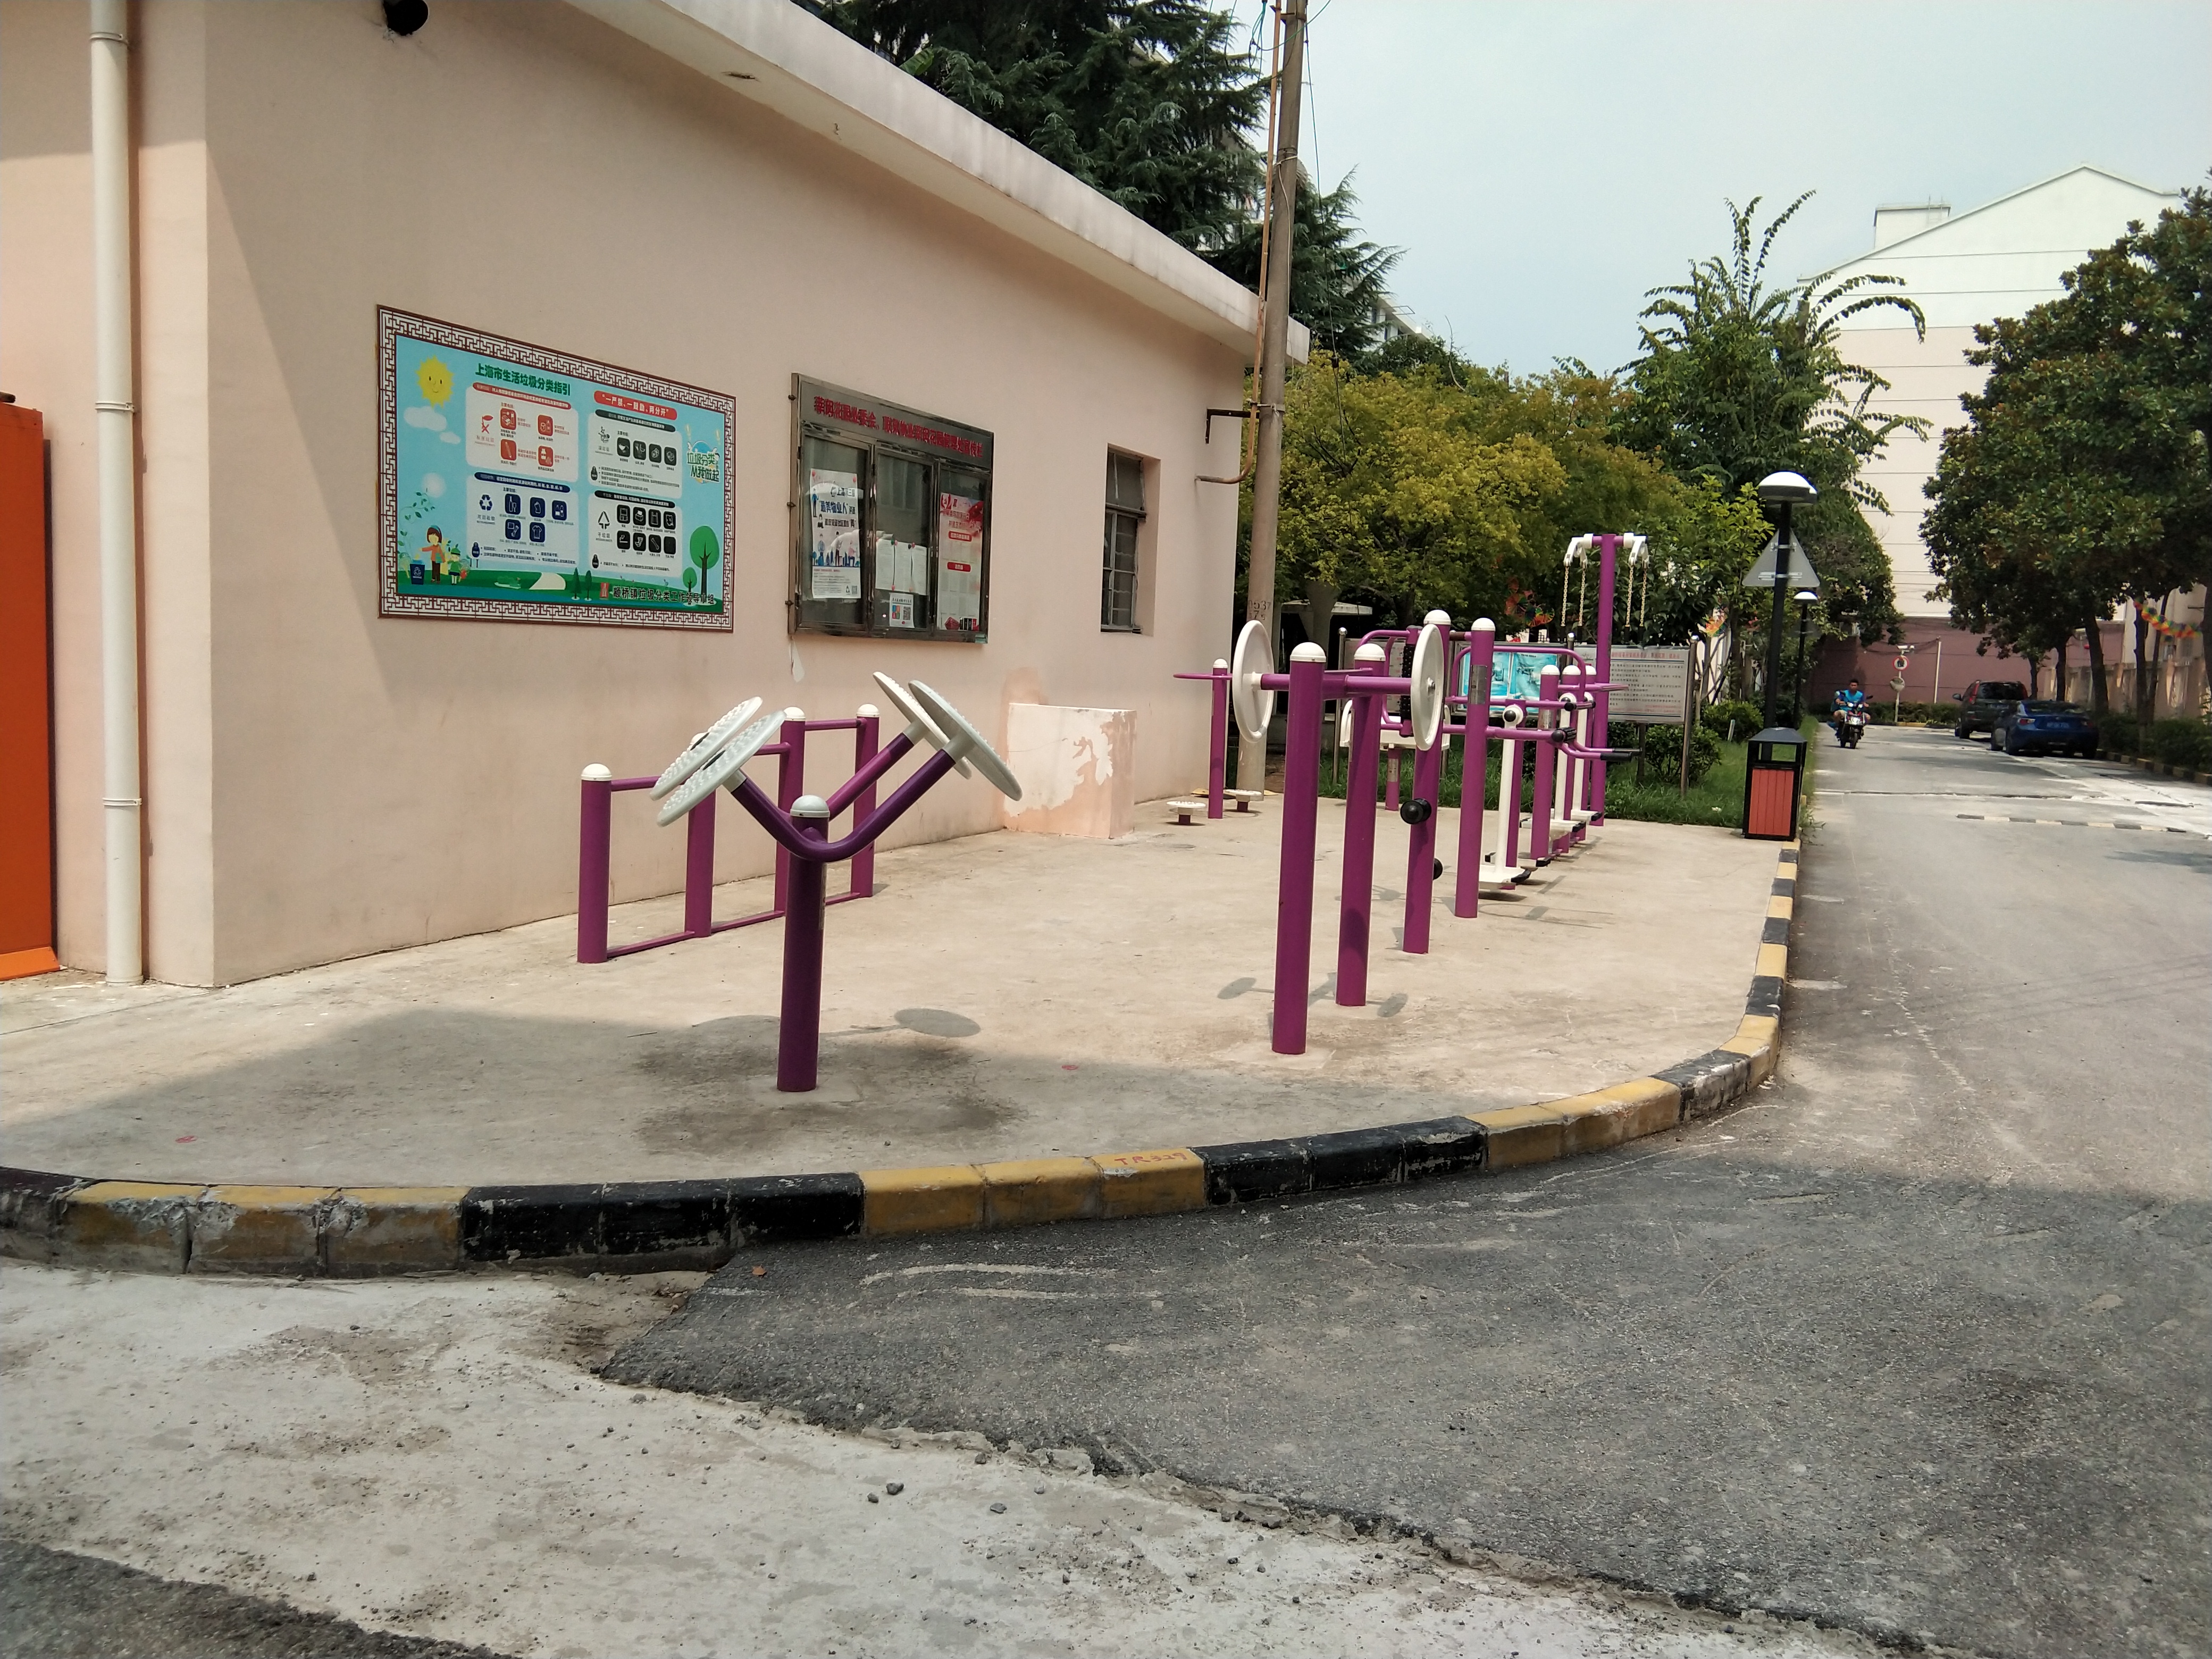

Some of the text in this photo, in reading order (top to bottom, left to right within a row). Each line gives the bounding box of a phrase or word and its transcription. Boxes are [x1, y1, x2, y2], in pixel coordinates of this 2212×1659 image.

[475, 363, 571, 396] 上海市生活垃圾分类指引
[687, 453, 715, 466] 垃圾分类
[691, 465, 719, 482] 从我做起
[613, 586, 715, 605] 颛桥镇垃圾分类工作领导小组
